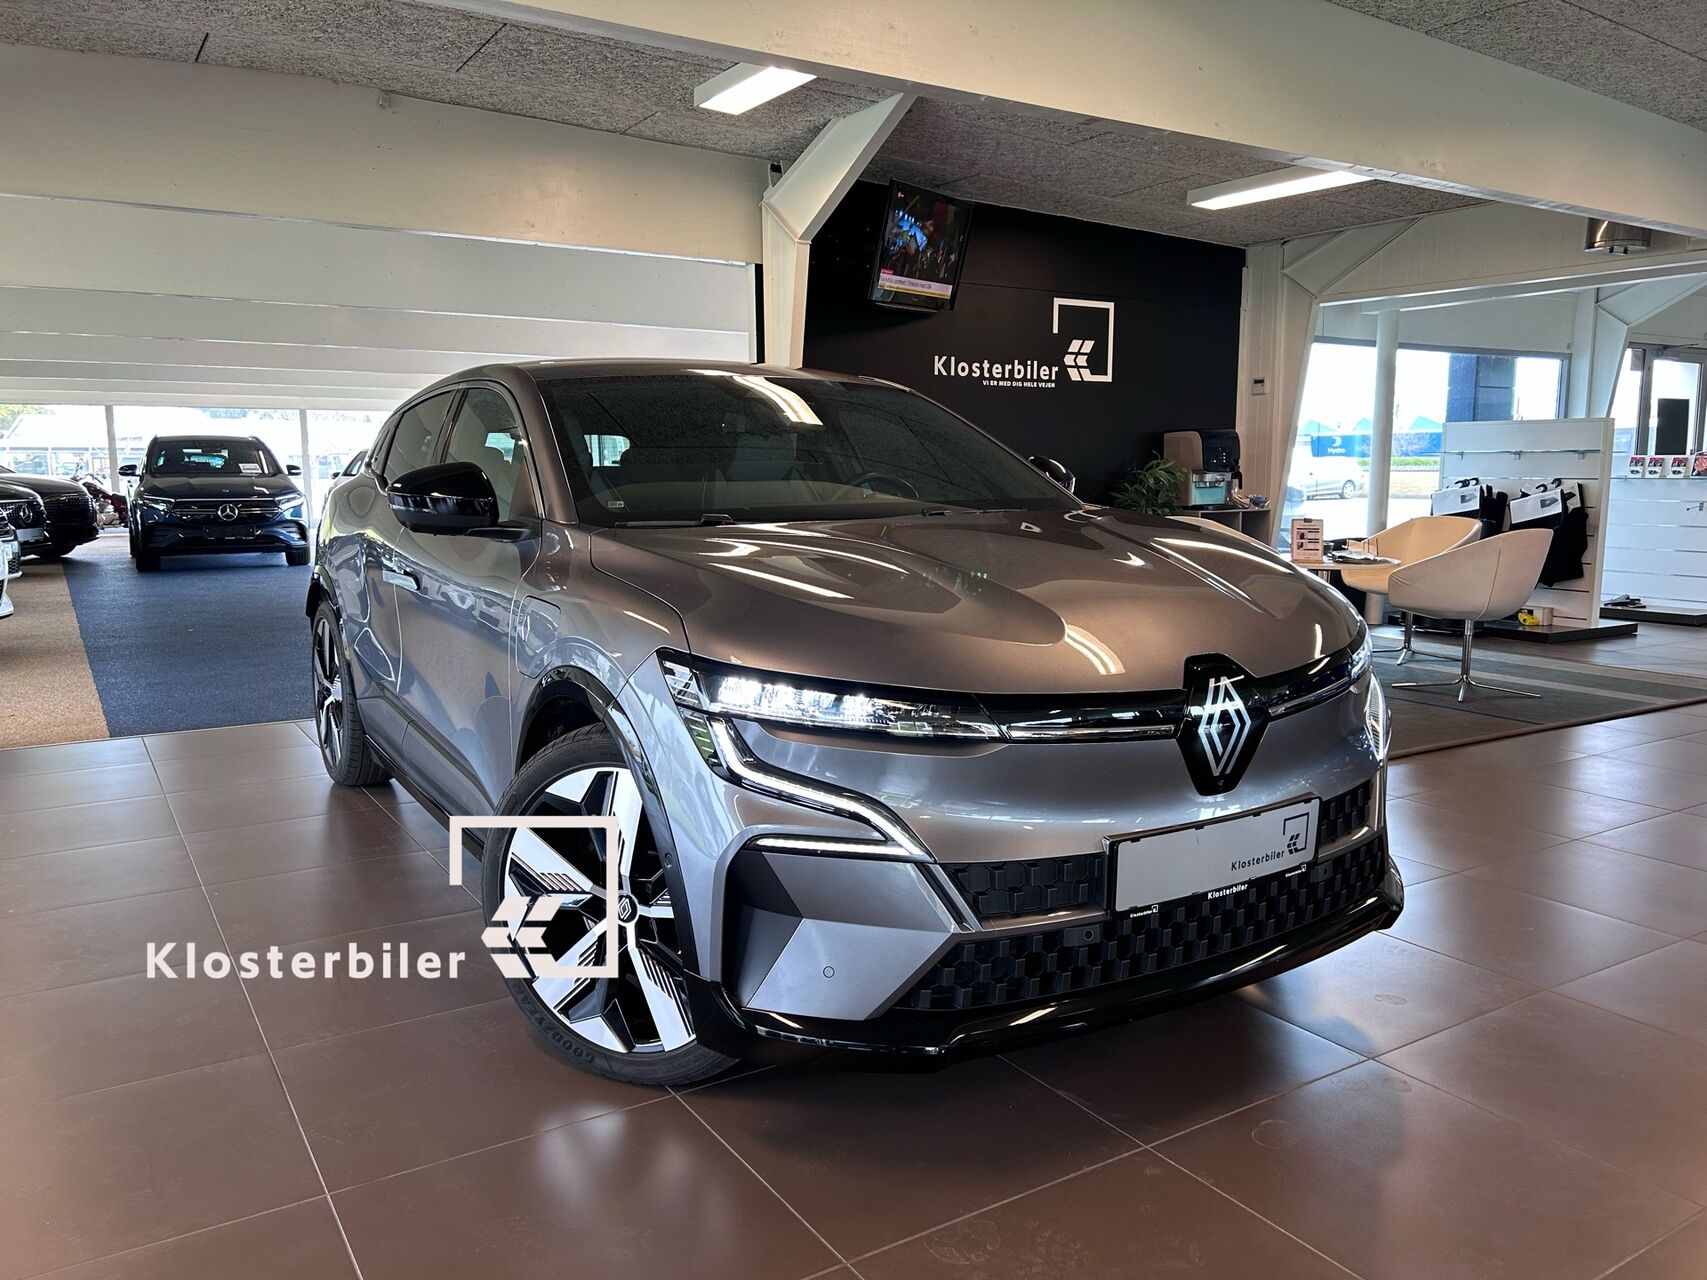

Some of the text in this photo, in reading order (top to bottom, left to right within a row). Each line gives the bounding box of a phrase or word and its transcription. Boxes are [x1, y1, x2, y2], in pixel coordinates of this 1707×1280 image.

[933, 355, 1059, 381] Klosterbiler
[1231, 849, 1285, 871] Klosterbiler
[1207, 883, 1248, 900] Klosterbiler
